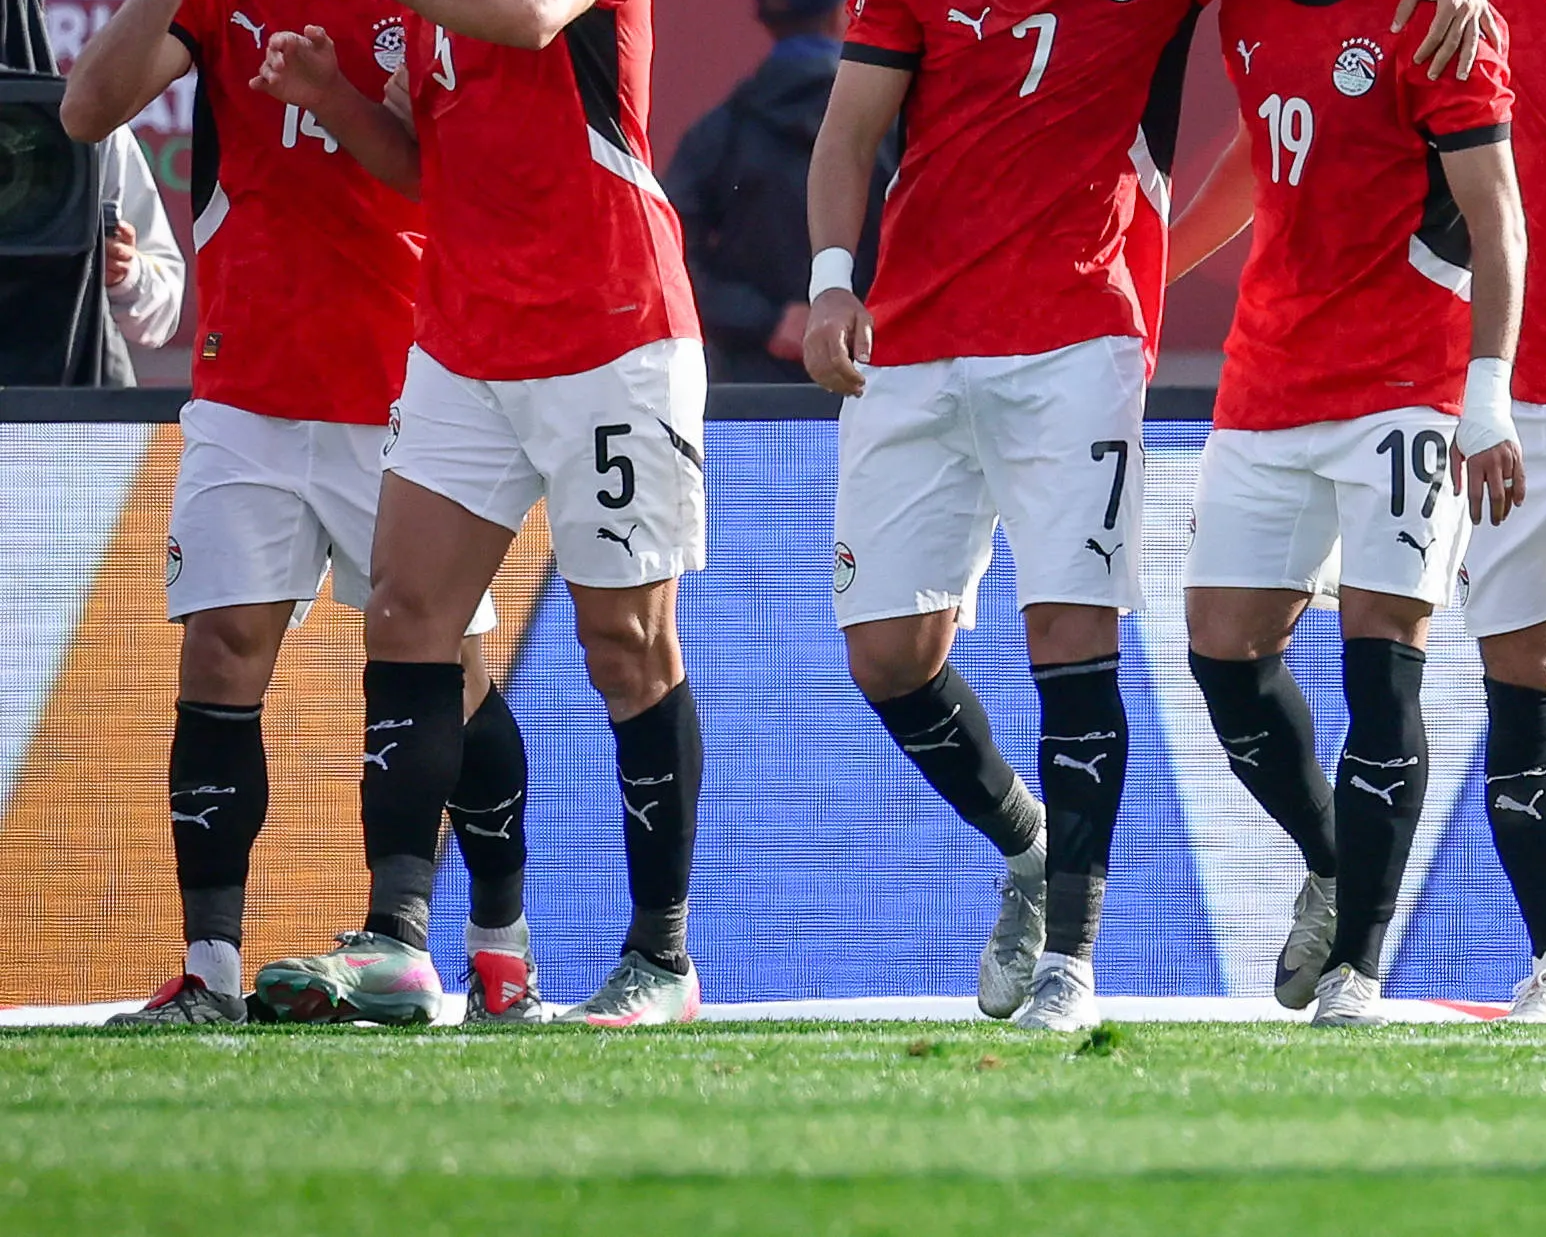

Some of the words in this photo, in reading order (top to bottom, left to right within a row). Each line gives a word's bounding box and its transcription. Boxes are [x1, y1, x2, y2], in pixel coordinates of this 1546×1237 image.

[1012, 13, 1057, 98] 7
[1257, 93, 1315, 187] 19
[594, 423, 636, 510] 5
[1091, 439, 1129, 531] 7
[1376, 429, 1448, 519] 19
